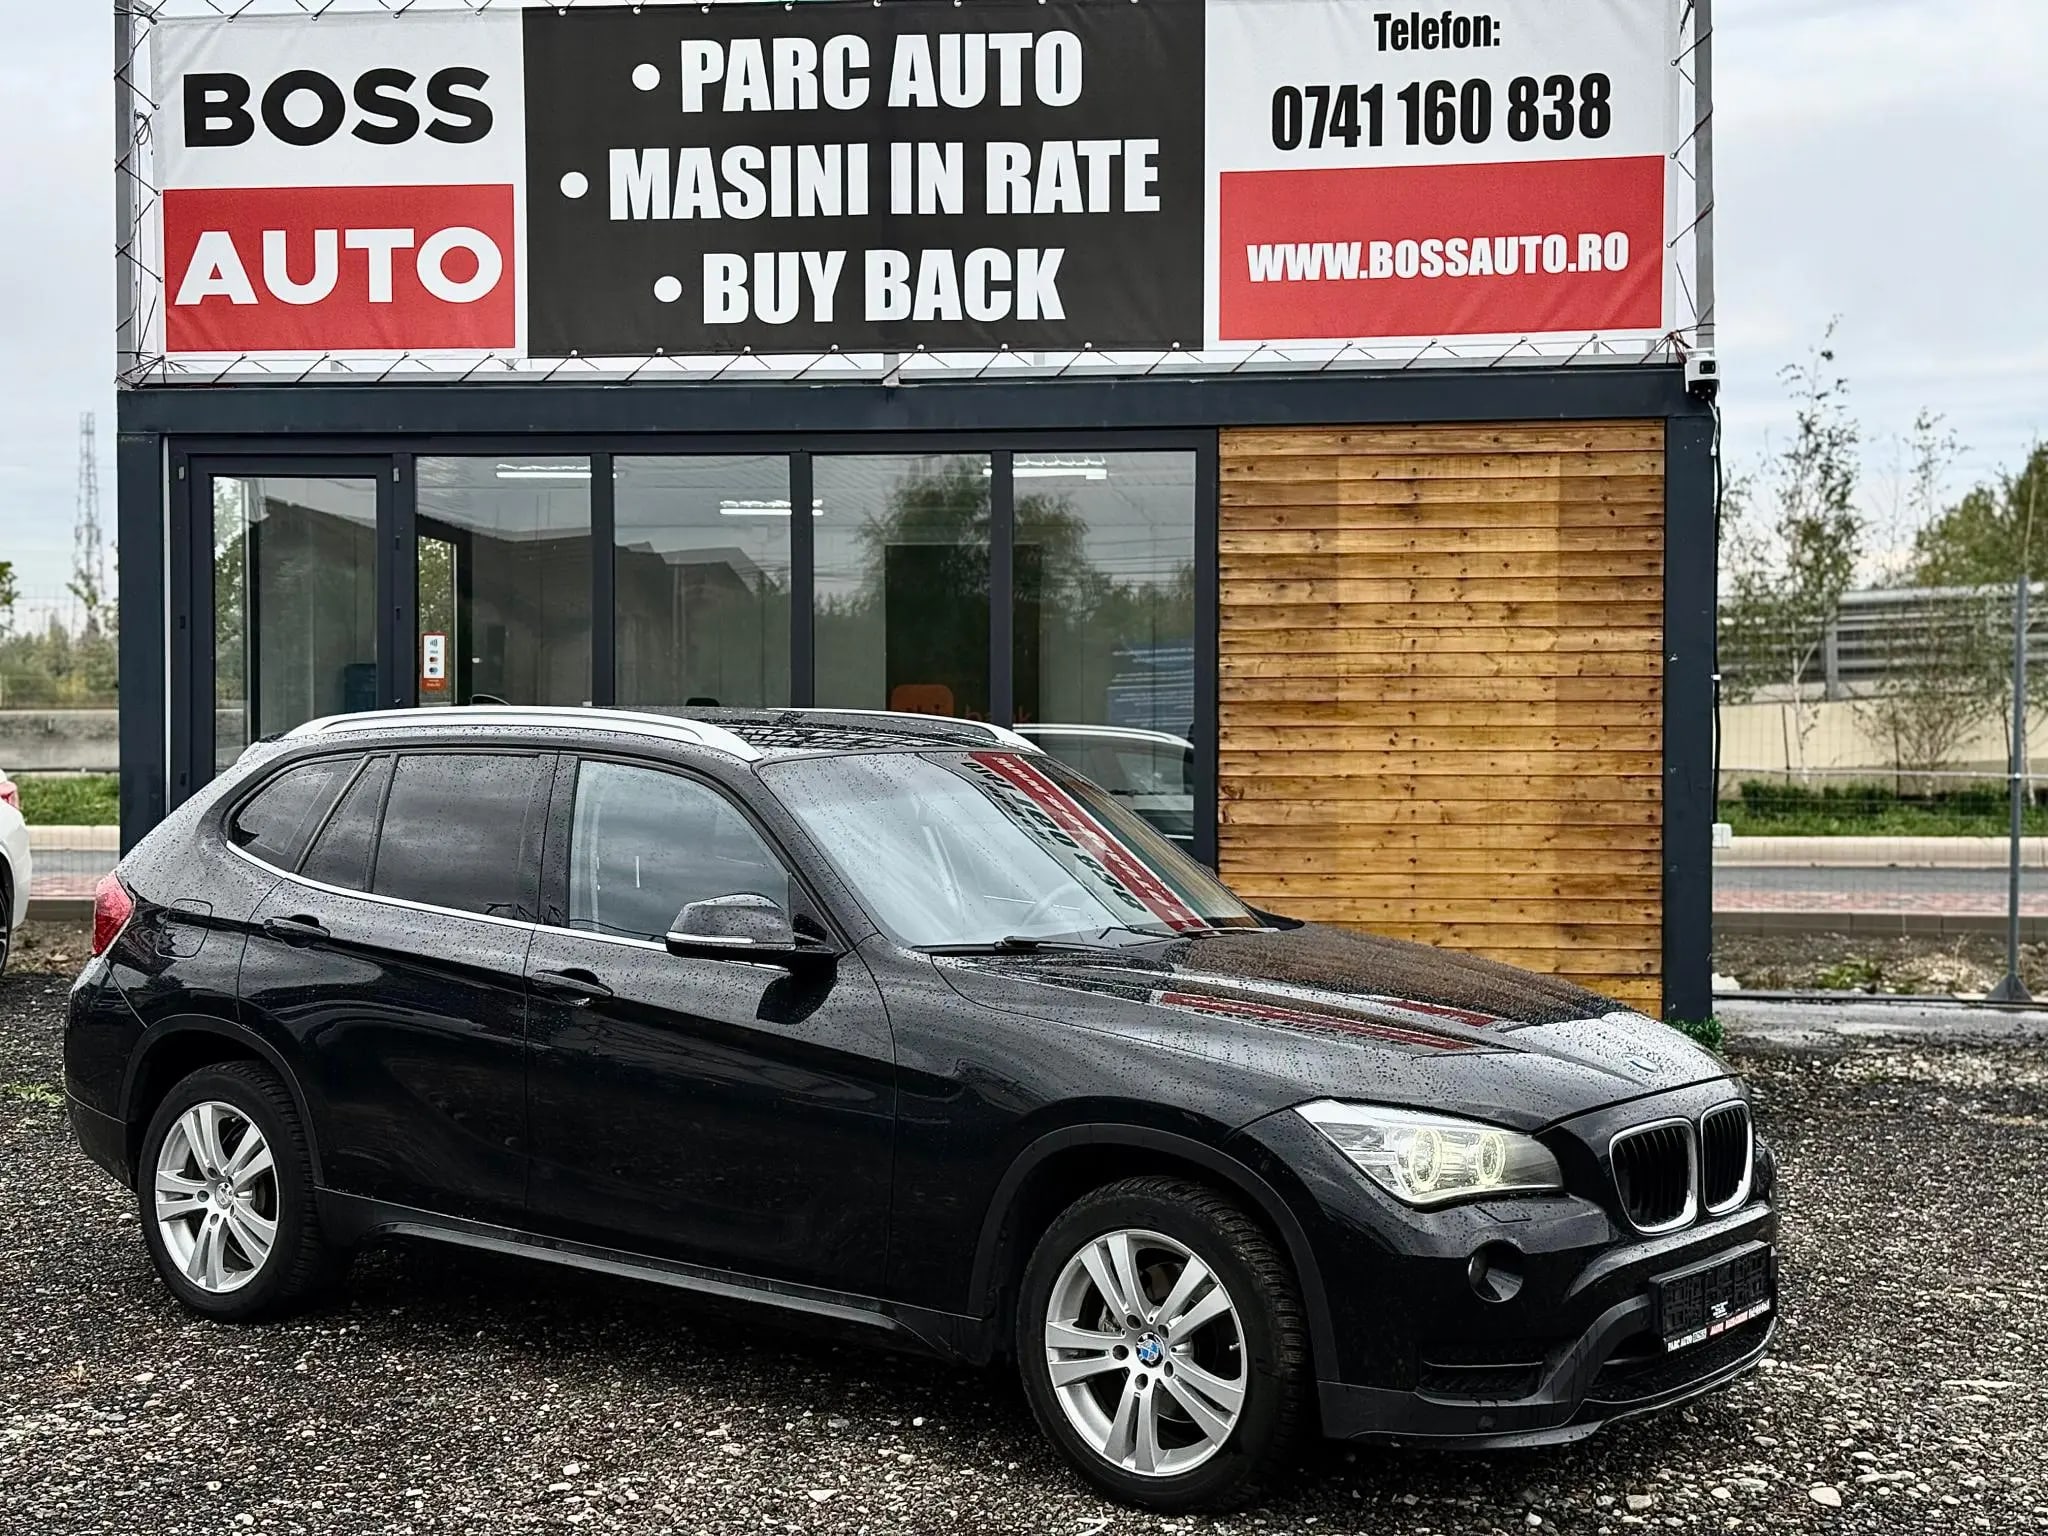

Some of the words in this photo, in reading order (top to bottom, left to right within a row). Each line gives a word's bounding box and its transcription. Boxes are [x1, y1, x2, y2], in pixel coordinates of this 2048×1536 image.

[1374, 11, 1501, 52] Telefon:
[183, 66, 494, 148] BOSS
[681, 35, 870, 113] PARC
[888, 31, 1083, 109] AUTO
[1272, 84, 1383, 151] 0741
[1398, 79, 1492, 146] 160
[1508, 73, 1611, 143] 838
[609, 143, 869, 221] MASINI
[891, 142, 964, 215] IN
[986, 139, 1161, 215] RATE
[174, 227, 503, 306] AUTO
[703, 251, 847, 325] BUY
[865, 248, 1066, 322] BACK
[1247, 231, 1629, 282] WWW.BOSSAUTO.RO
